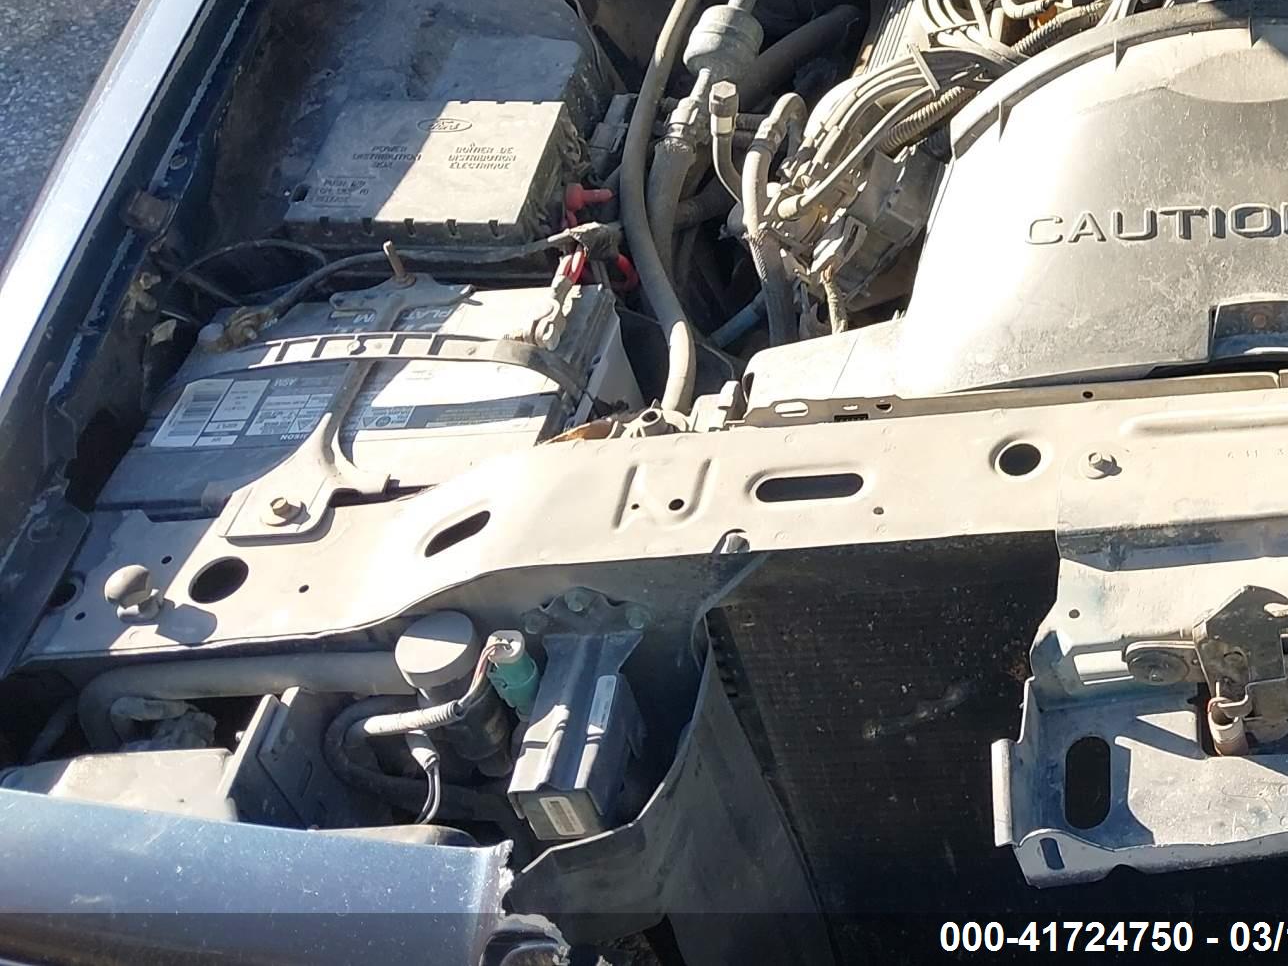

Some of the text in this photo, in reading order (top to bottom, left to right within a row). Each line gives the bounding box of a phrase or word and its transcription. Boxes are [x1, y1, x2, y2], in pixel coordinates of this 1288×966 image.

[370, 145, 407, 153] POWER
[352, 153, 422, 161] DISTRIBUTION
[448, 154, 517, 162] DISTRIBUTION
